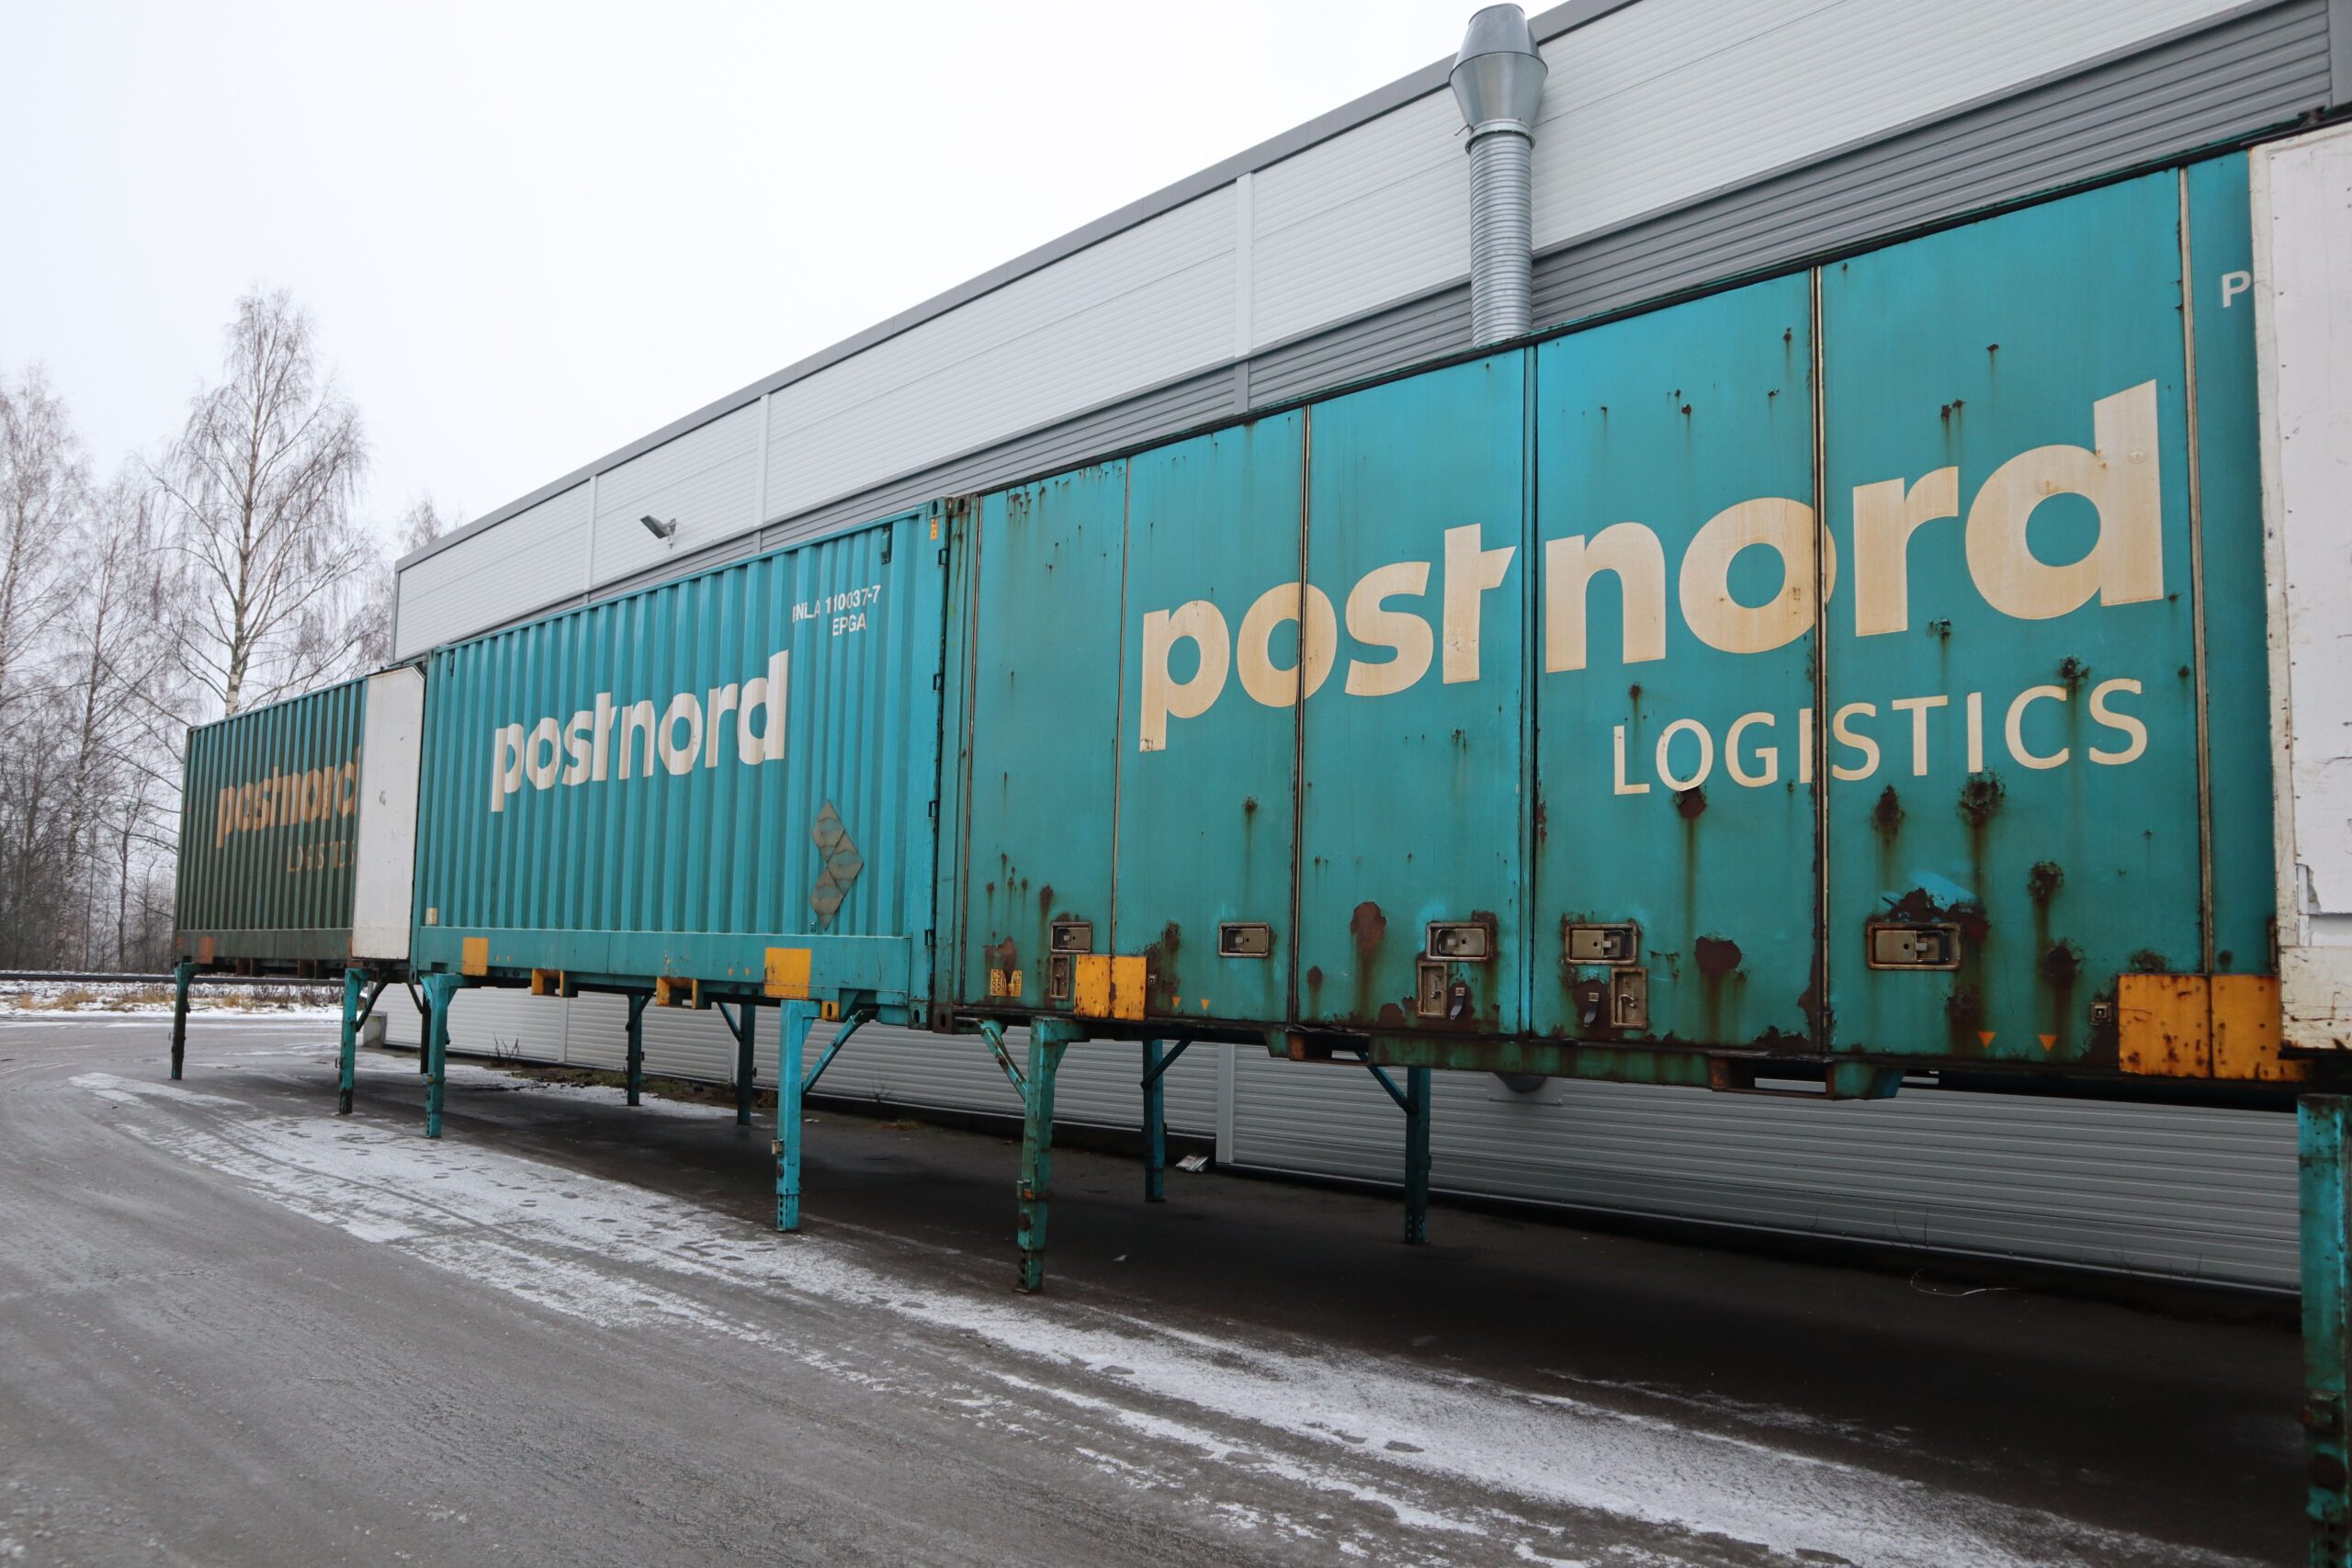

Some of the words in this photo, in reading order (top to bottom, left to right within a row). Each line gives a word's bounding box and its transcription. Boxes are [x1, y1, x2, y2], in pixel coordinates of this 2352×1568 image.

[825, 584, 881, 615] 110037-7
[1139, 378, 2164, 752] postnord
[831, 613, 866, 637] EPGA
[491, 649, 788, 812] postnord
[1614, 678, 2149, 795] LOGISTICS
[216, 745, 360, 849] postnord
